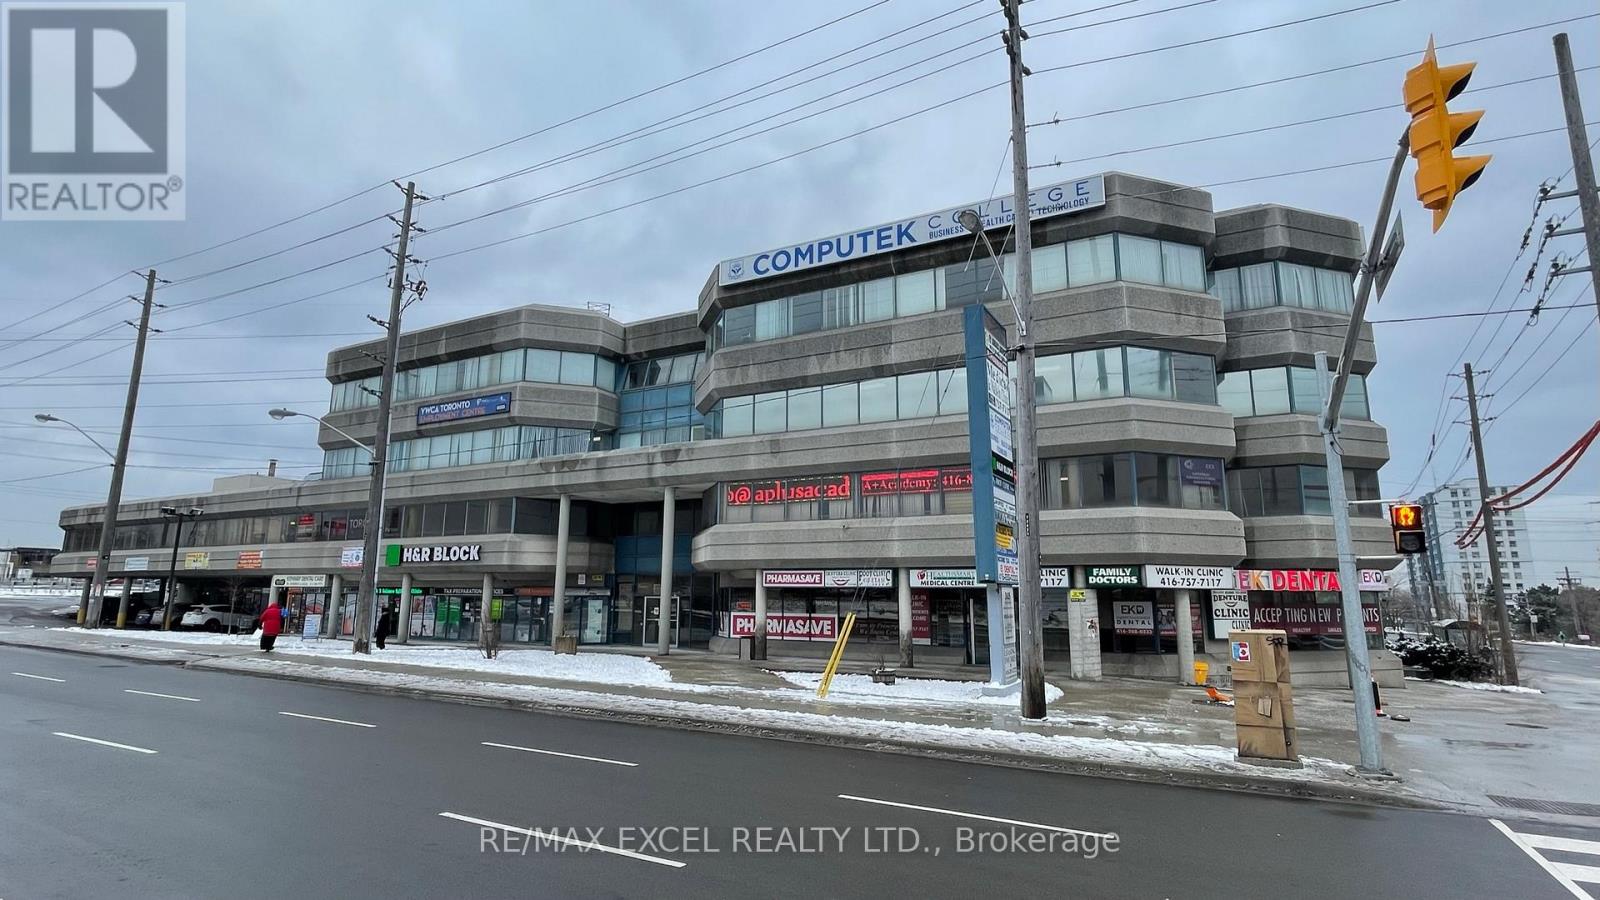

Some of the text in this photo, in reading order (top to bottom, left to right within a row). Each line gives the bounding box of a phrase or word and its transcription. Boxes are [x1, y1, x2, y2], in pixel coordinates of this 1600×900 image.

[753, 221, 917, 275] COMPUTEK
[421, 404, 439, 415] YWCA
[440, 401, 471, 412] TORONTO
[403, 545, 480, 562] H&R BLOCK
[1041, 569, 1066, 577] LINIC
[1093, 567, 1132, 576] FAMILY
[1155, 567, 1223, 577] WALK-IN CLINIC
[766, 574, 821, 584] PHARMASAVE
[1088, 576, 1138, 584] DOCTORS
[1160, 577, 1222, 587] 416-757-7117
[1272, 569, 1343, 591] DENTA
[1362, 571, 1382, 583] EKD
[1213, 594, 1248, 602] DENTURE
[1214, 608, 1249, 618] CLINIC
[736, 617, 832, 635] PHRMASAVE
